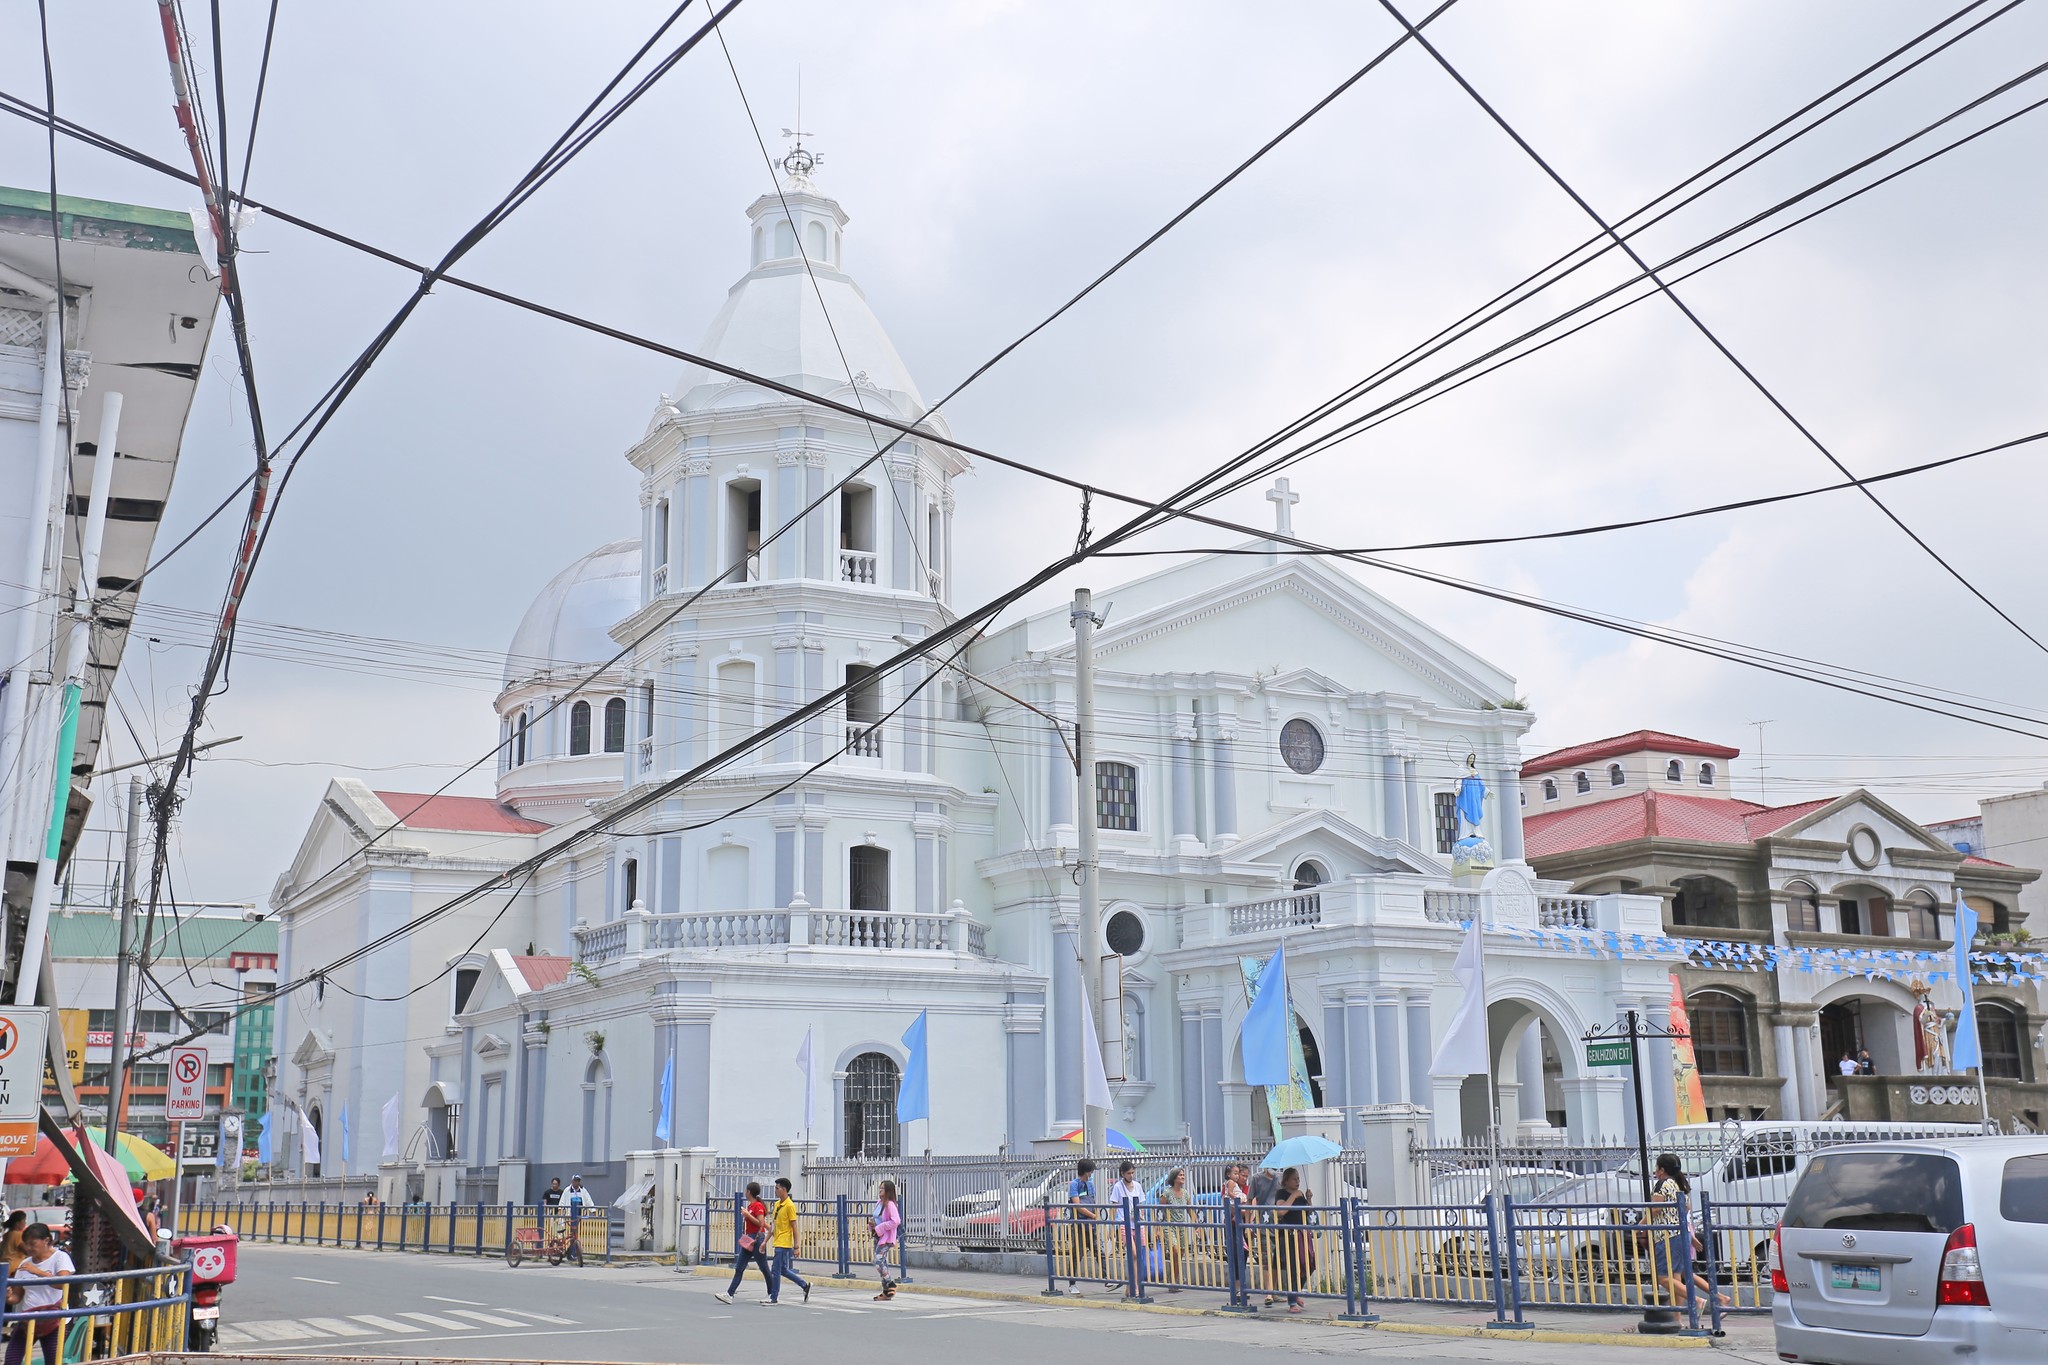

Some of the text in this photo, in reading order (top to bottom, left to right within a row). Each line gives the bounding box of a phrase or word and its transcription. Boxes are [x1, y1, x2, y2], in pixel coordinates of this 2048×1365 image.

[1618, 1048, 1629, 1060] EXT
[182, 1086, 192, 1096] NO
[171, 1100, 200, 1109] PARKING
[683, 1207, 703, 1221] EXI
